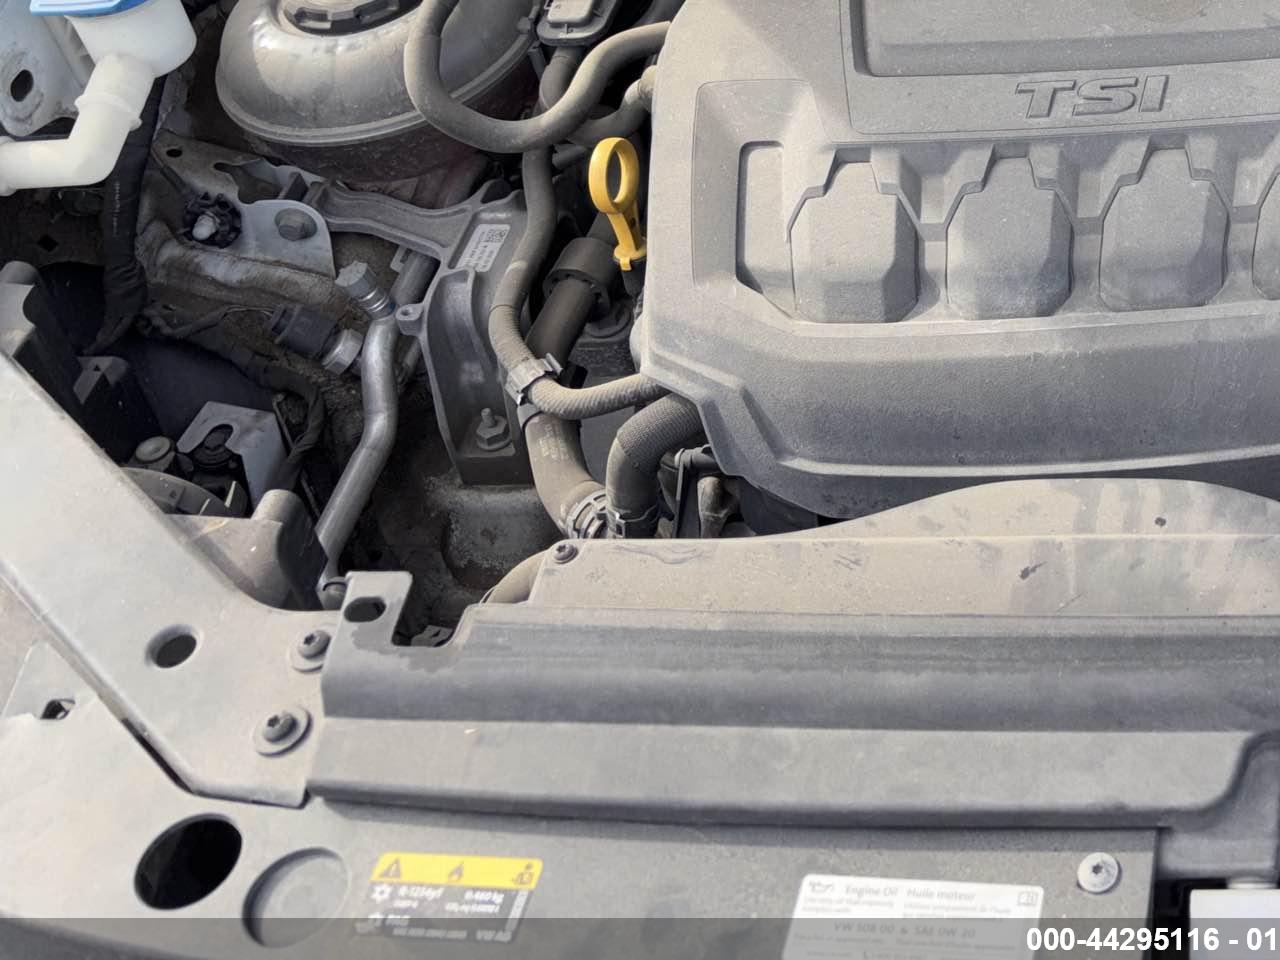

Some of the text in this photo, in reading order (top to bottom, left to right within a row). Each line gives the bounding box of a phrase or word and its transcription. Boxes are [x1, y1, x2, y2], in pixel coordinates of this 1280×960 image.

[1015, 74, 1170, 118] TSI
[845, 885, 881, 899] Engine
[906, 887, 976, 901] Huile moteur
[834, 922, 855, 933] VW
